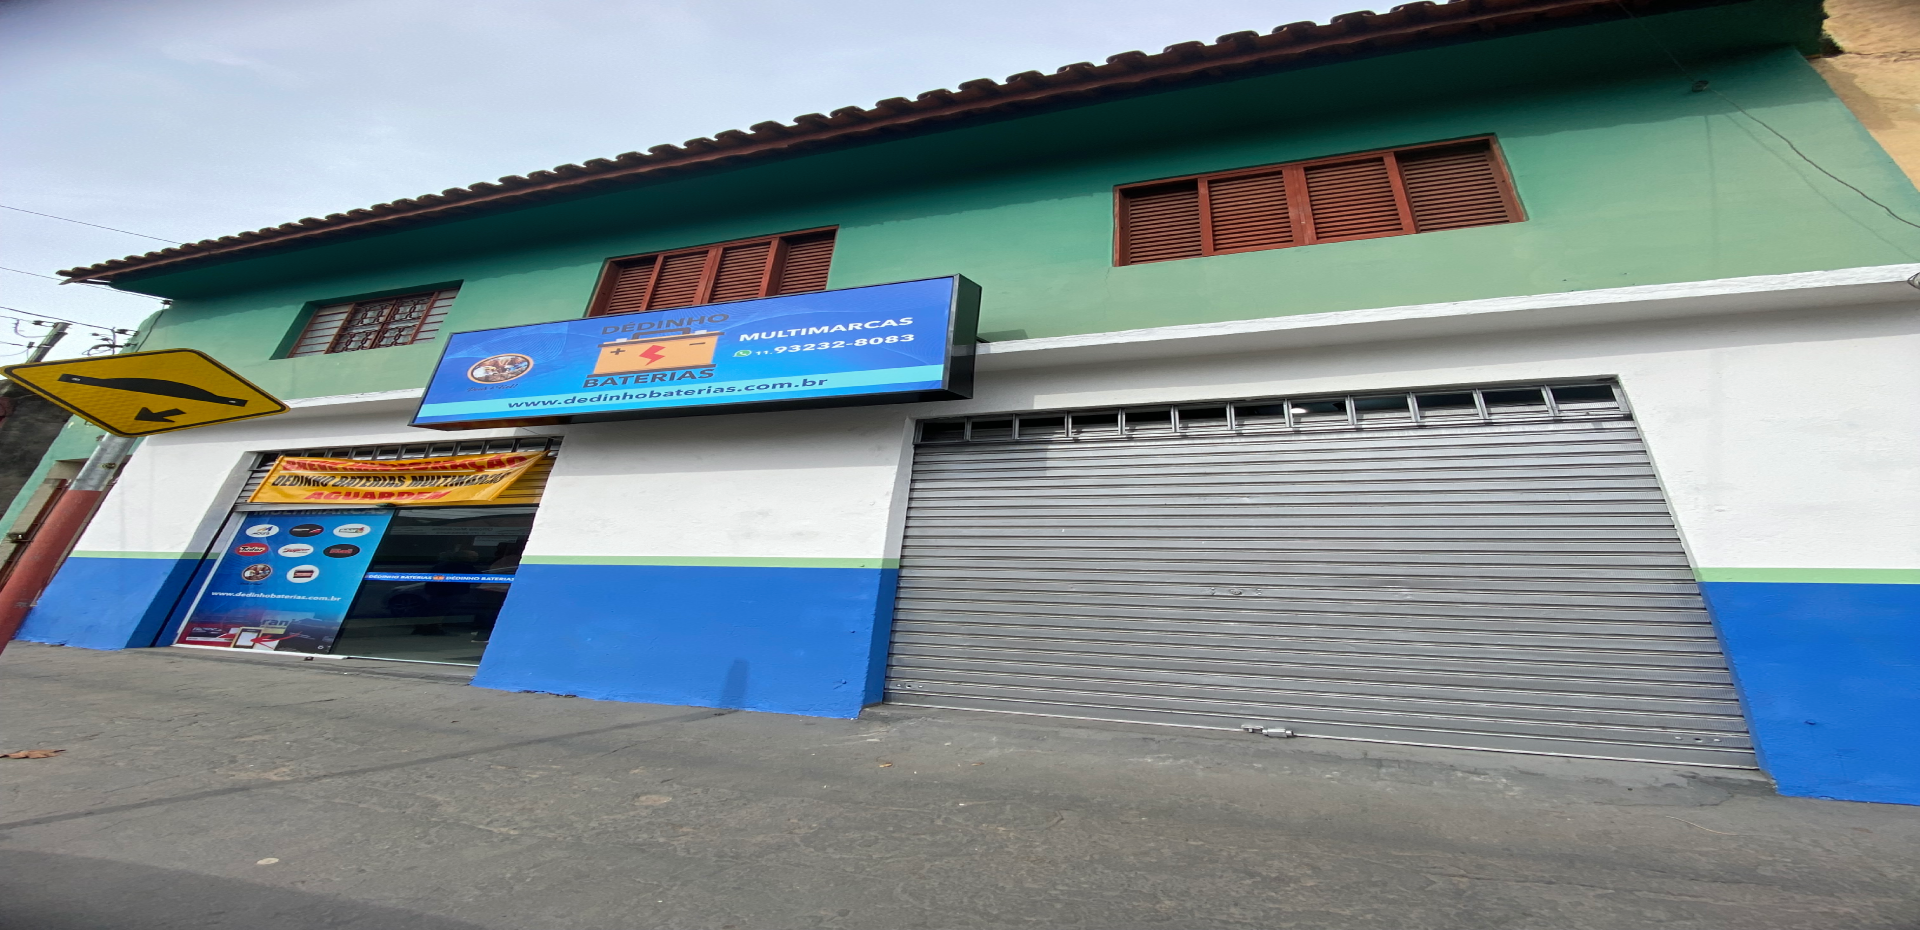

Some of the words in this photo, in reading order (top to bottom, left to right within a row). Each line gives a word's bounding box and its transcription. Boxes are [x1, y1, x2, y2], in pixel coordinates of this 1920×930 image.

[739, 317, 914, 342] MULTIMARCAS
[582, 368, 715, 388] BATERIAS
[507, 378, 829, 408] www.dedinhobaterias.com.br
[271, 474, 335, 487] DEDINHO
[331, 475, 406, 488] BATERIAS
[304, 490, 451, 501] AGUARDEM
[211, 591, 341, 602] www.dedinhobaterias.com.br
